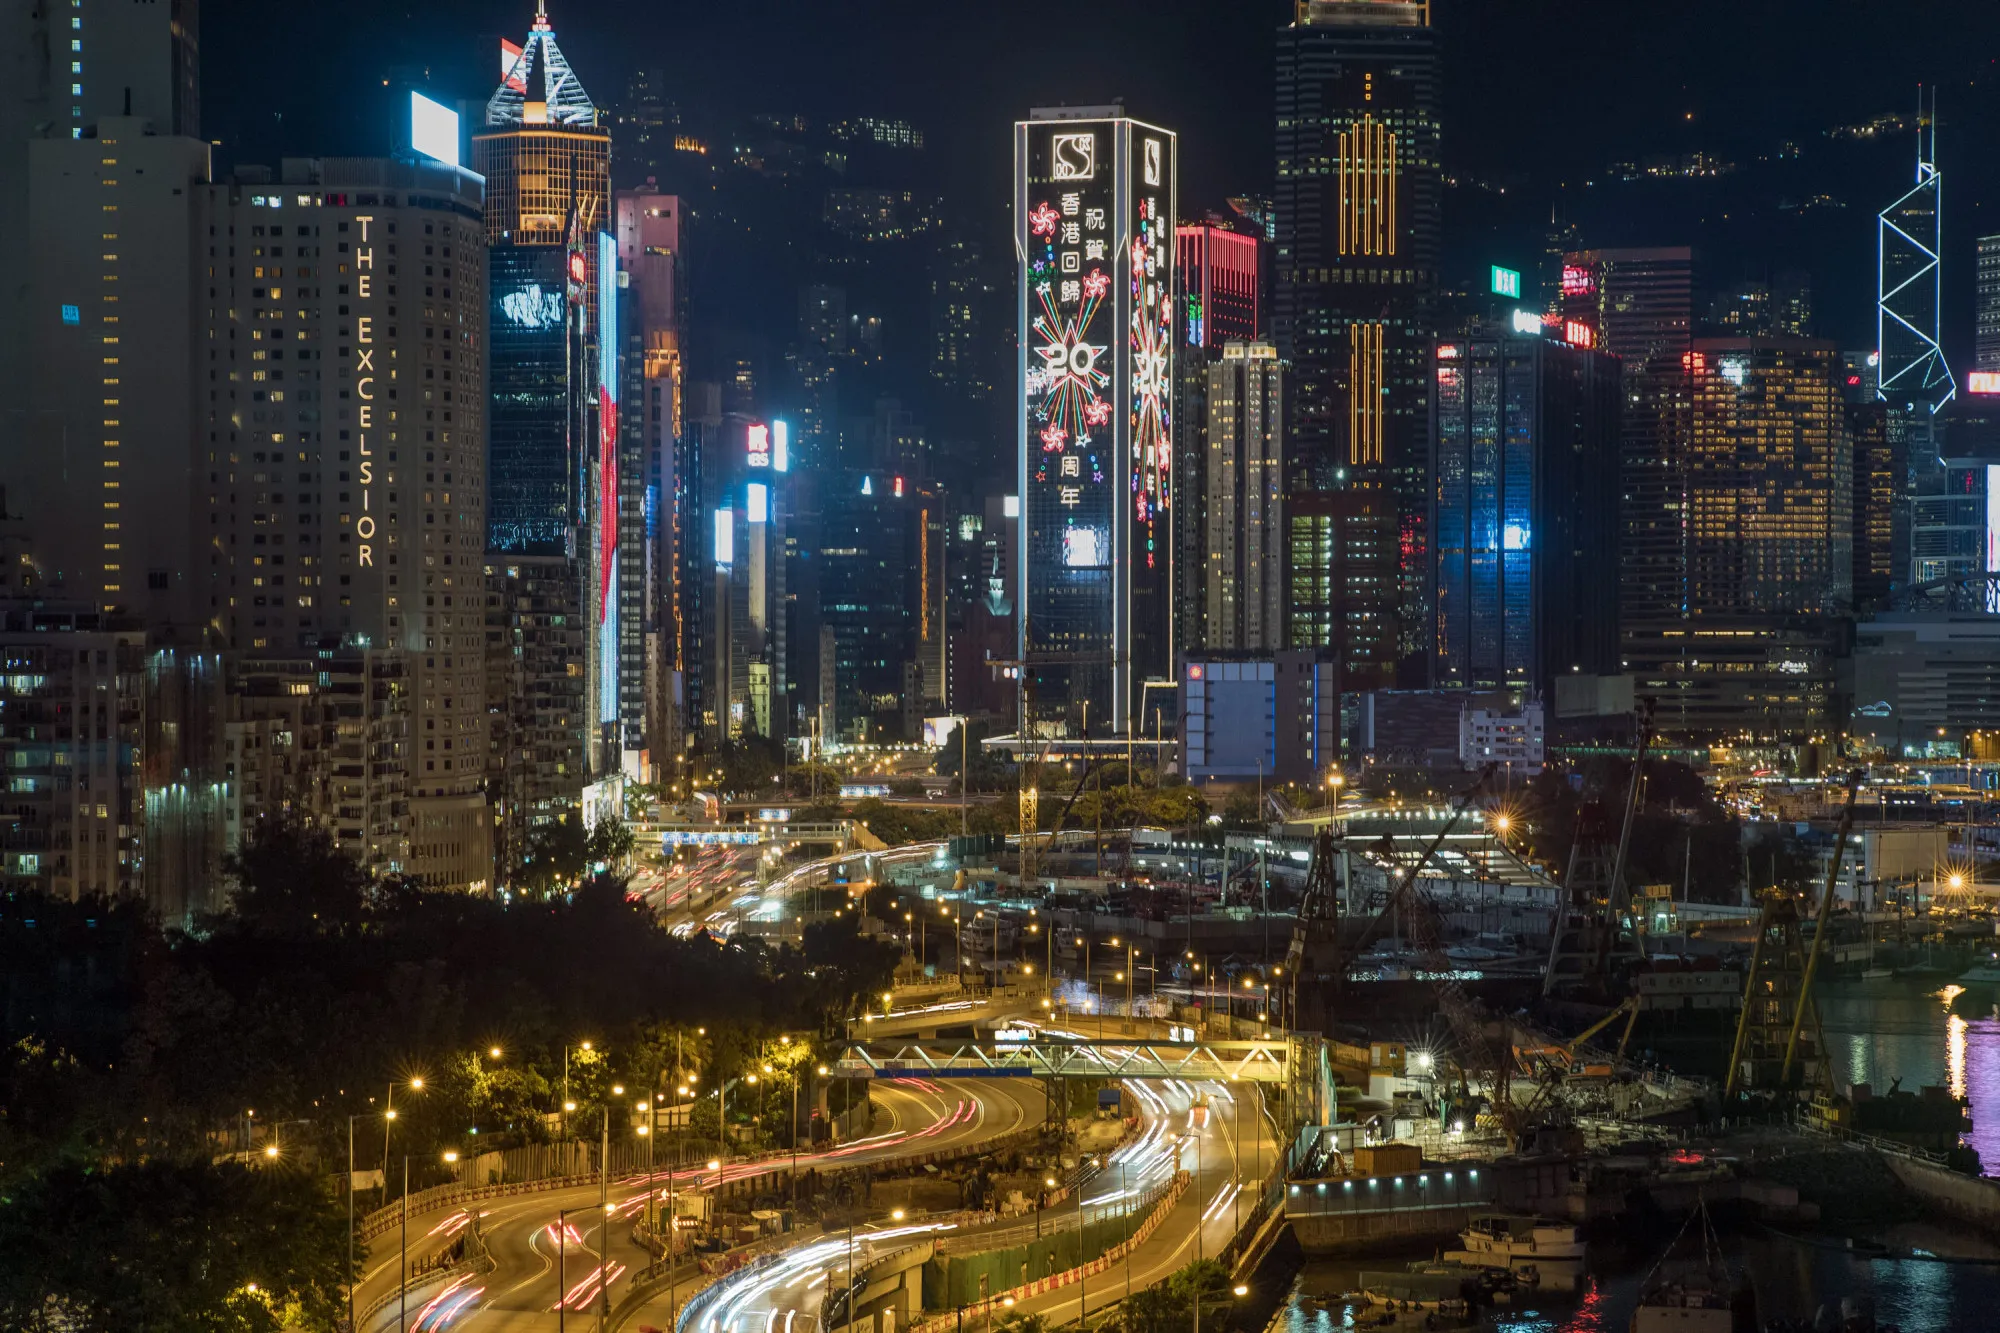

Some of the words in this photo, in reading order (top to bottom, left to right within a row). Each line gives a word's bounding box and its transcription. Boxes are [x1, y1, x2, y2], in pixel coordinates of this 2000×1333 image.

[356, 216, 373, 298] THE
[1061, 192, 1080, 303] 香港回歸
[1085, 208, 1105, 261] 祝賀
[1046, 342, 1095, 377] 20
[356, 317, 375, 567] EXCELSIOR
[1060, 455, 1080, 509] 周年
